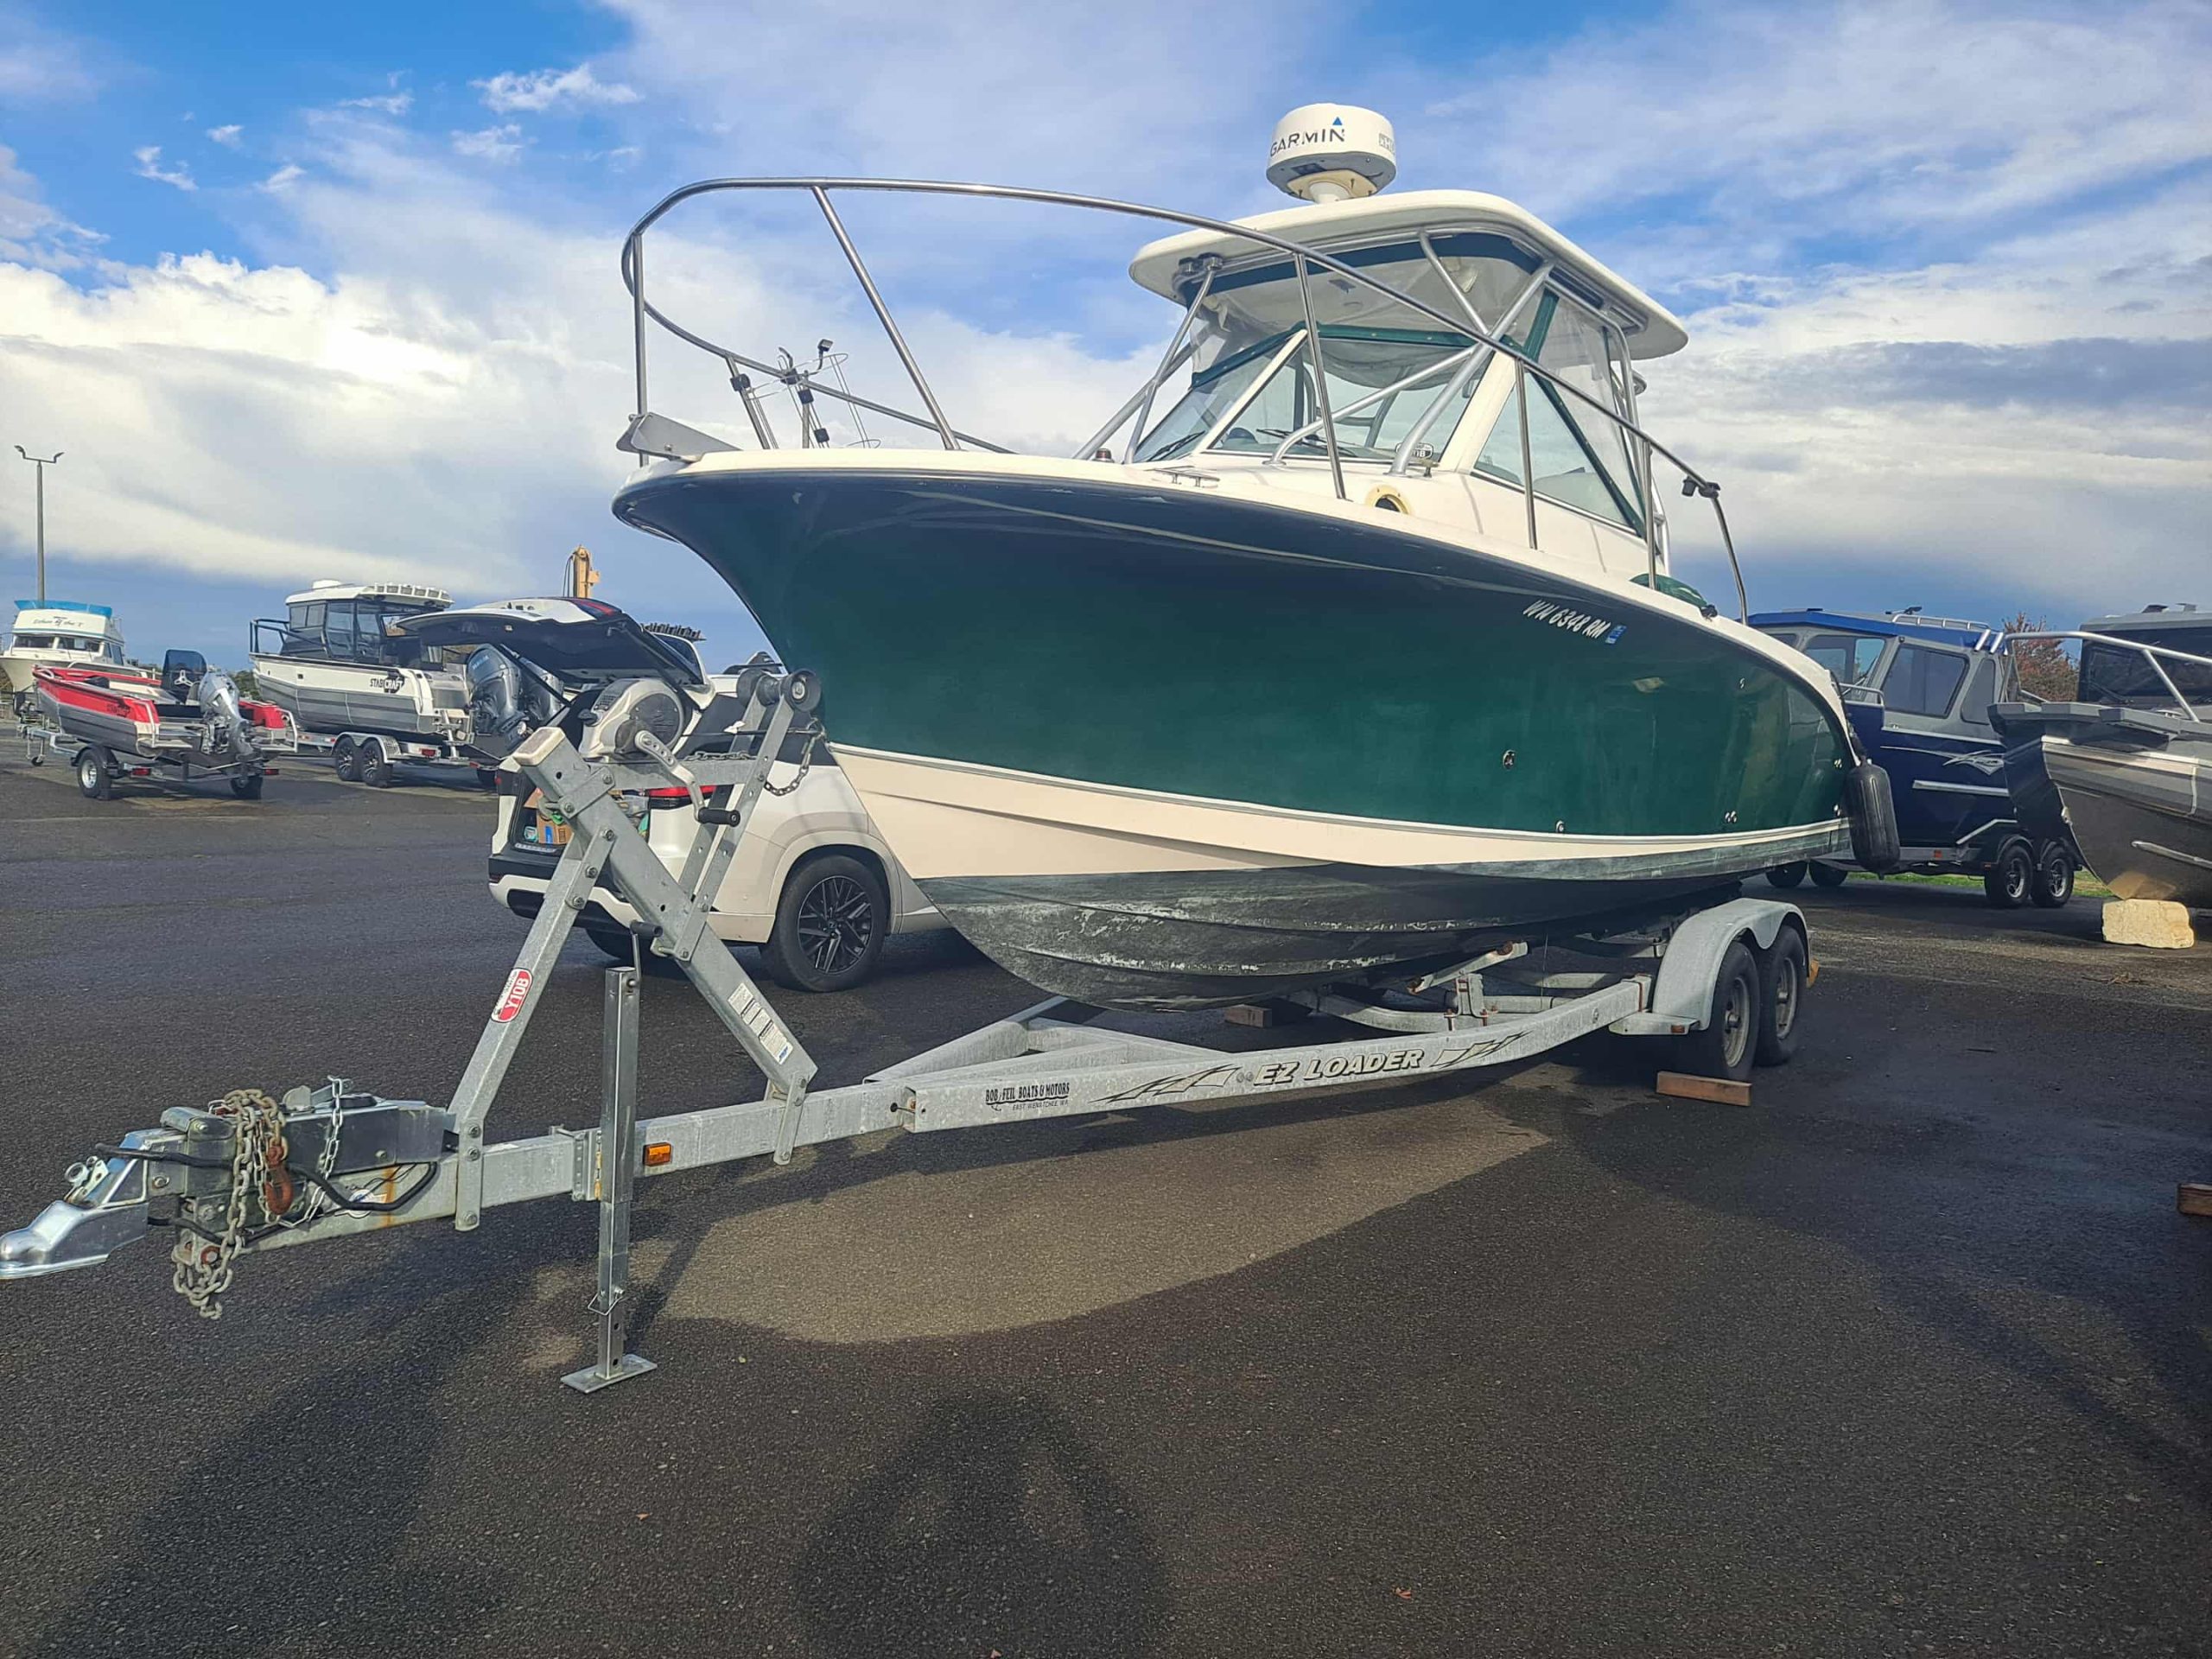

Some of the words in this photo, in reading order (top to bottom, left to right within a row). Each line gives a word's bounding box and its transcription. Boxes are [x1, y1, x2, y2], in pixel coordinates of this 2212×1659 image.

[1270, 129, 1344, 156] GARMIN
[1522, 599, 1560, 620] WN
[1582, 619, 1611, 639] RM
[1254, 1062, 1300, 1086] EZ
[1304, 1049, 1425, 1080] LOADER
[985, 1089, 999, 1102] BOB
[1002, 1088, 1015, 1100] FEIL
[1019, 1085, 1039, 1098] BOATS
[1046, 1083, 1070, 1096] MOTORS
